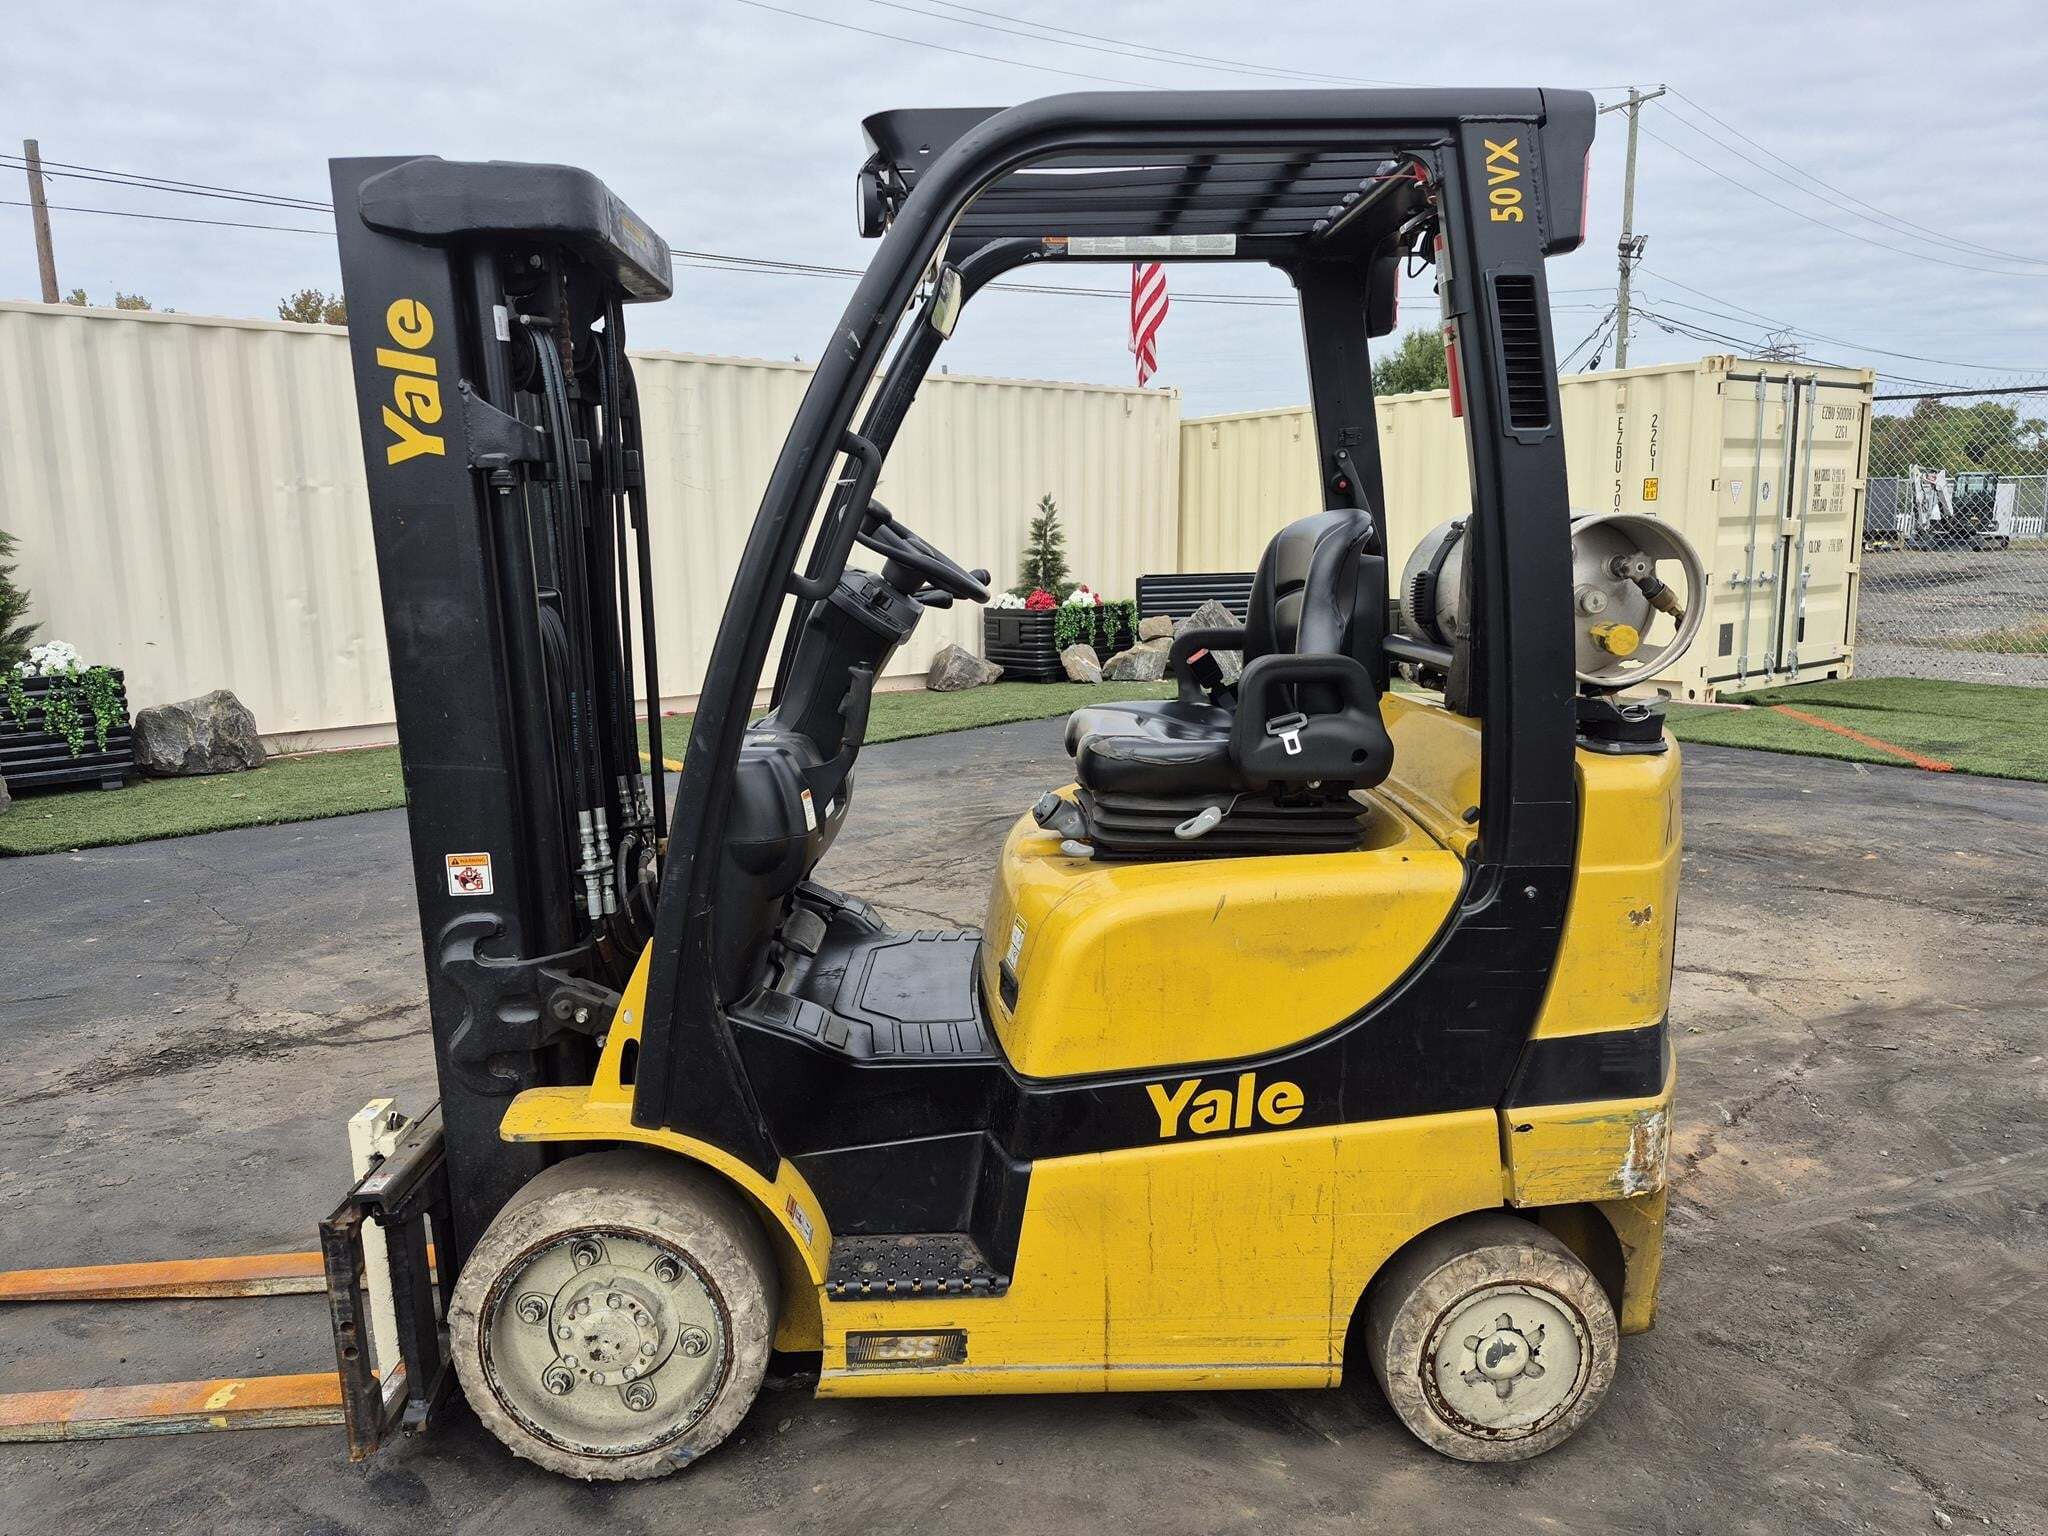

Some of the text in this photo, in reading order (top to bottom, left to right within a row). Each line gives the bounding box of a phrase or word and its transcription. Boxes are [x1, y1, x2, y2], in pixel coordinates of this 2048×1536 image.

[1484, 138, 1525, 223] 50VX
[376, 298, 446, 466] Yale
[1615, 416, 1624, 474] EZBU
[1649, 413, 1659, 472] 22G1
[1145, 1072, 1305, 1138] Yale
